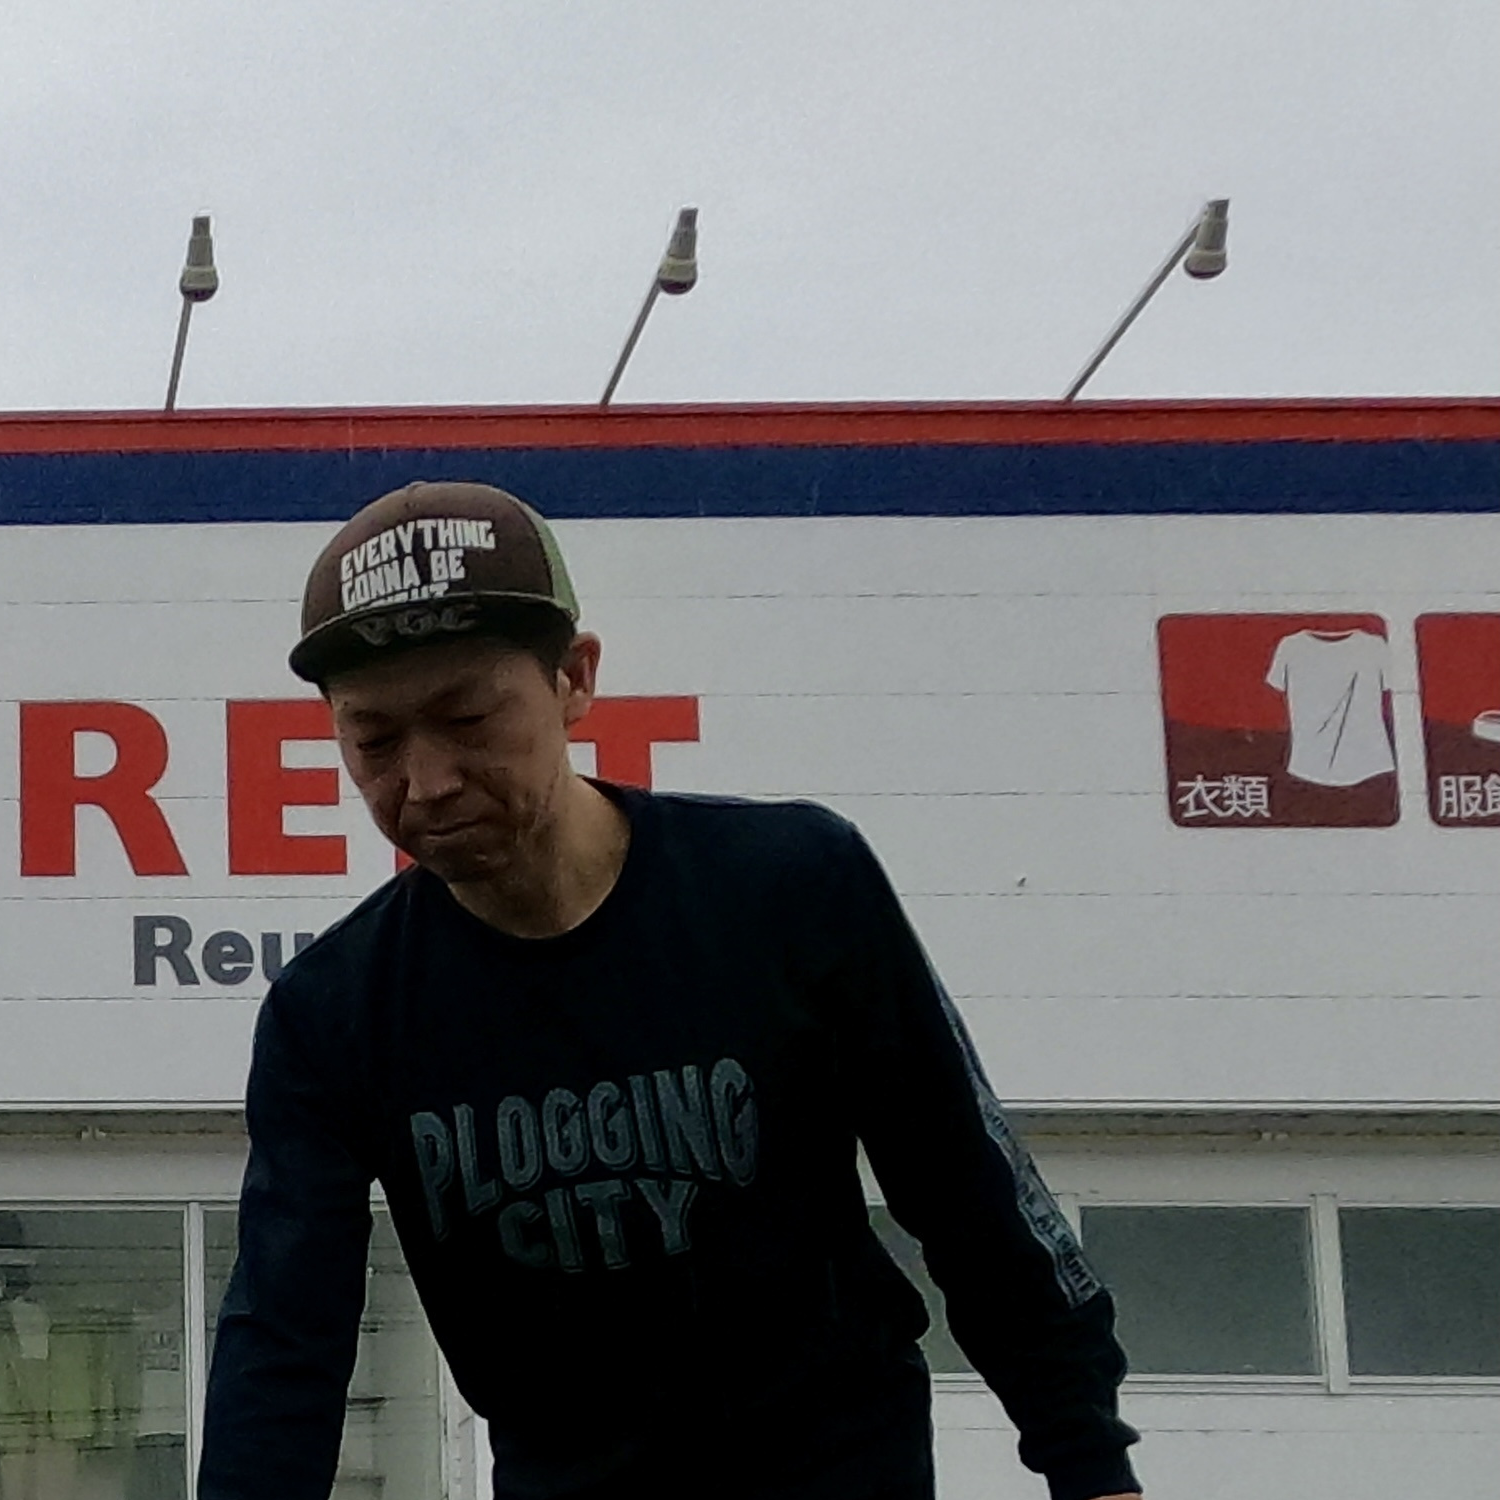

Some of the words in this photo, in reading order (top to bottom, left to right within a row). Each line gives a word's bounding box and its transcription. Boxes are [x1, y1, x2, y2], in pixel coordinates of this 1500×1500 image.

[340, 518, 496, 583] EVERYTHING
[341, 556, 422, 612] GONNA
[429, 548, 466, 583] BE
[1176, 774, 1272, 819] 衣類
[410, 1057, 759, 1242] PLOGGING
[497, 1178, 699, 1273] CITY
